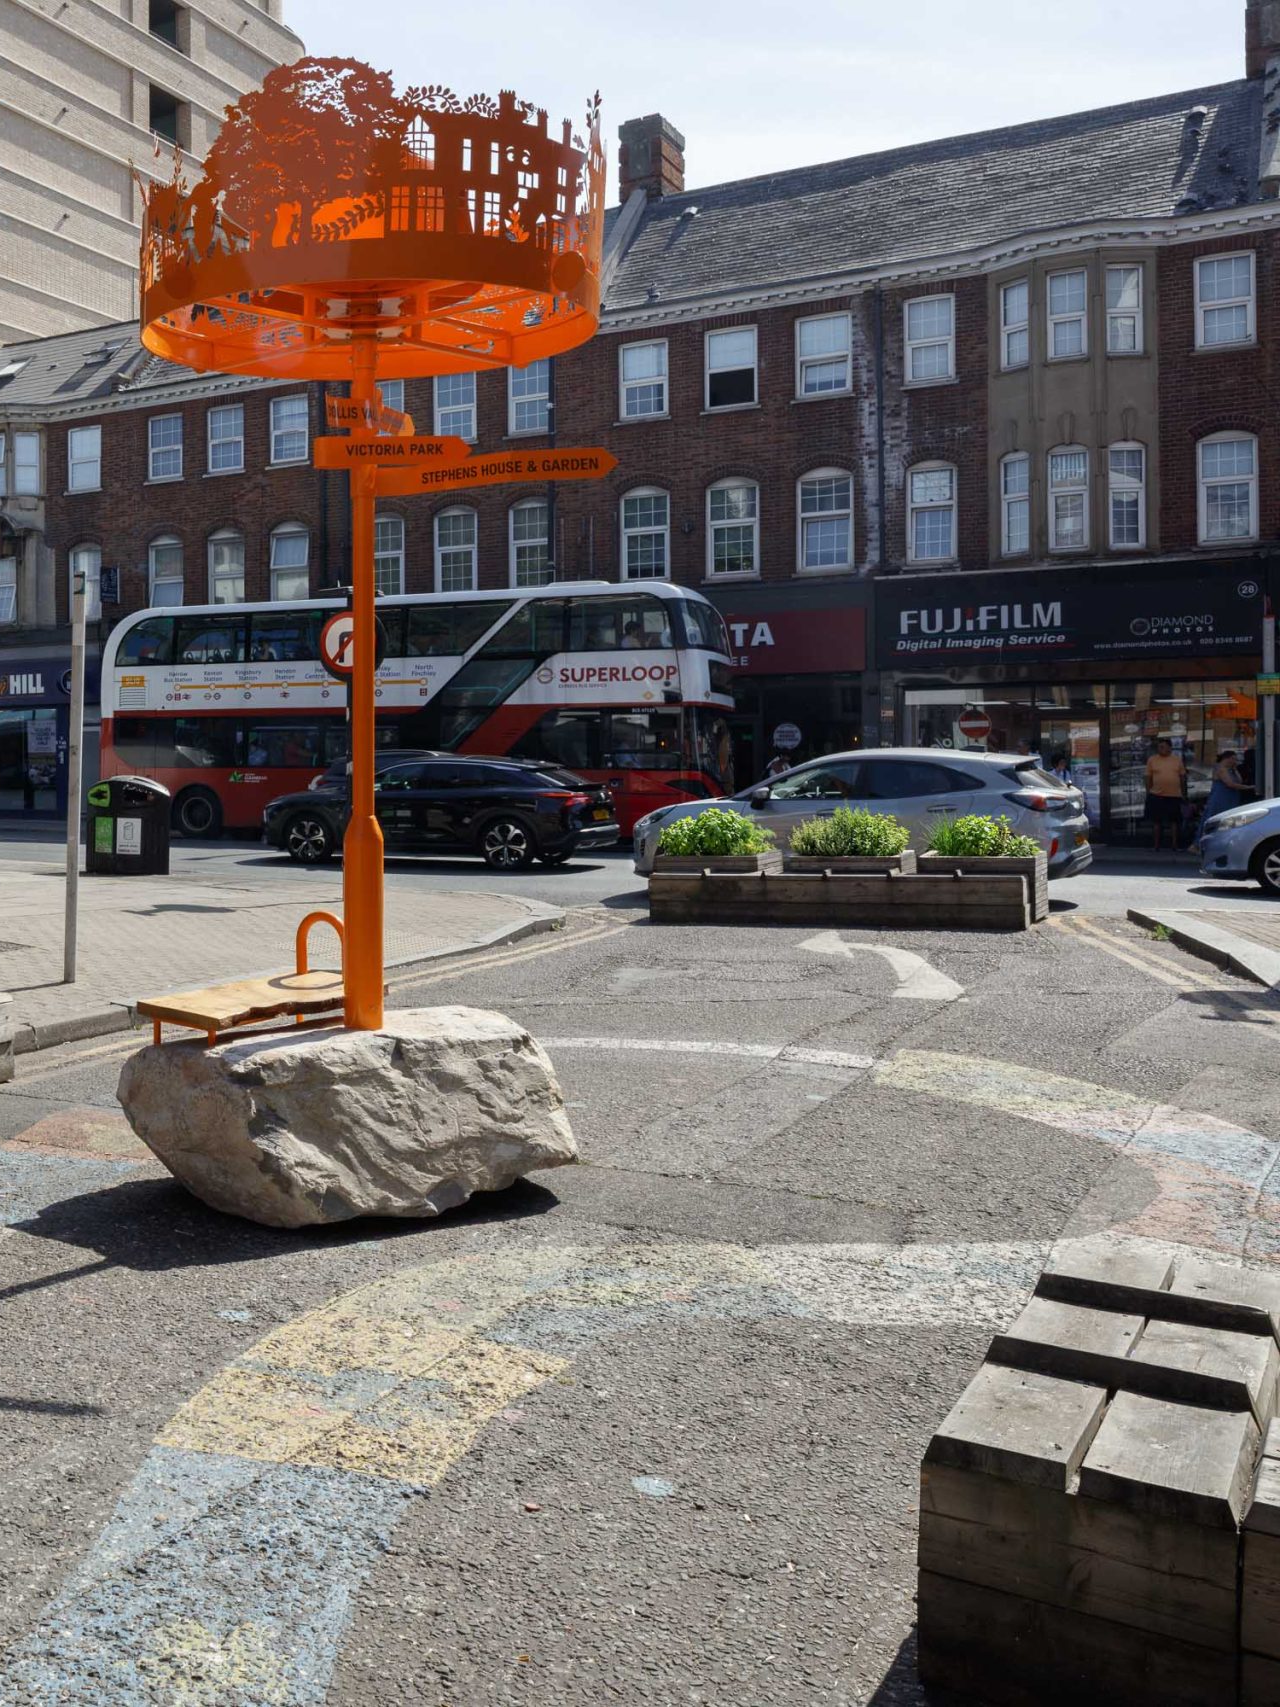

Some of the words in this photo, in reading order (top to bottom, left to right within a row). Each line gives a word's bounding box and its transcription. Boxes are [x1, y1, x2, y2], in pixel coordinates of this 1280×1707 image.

[346, 444, 405, 457] VICTORIA
[409, 443, 443, 455] PARK
[421, 466, 477, 485] STEPHENS
[481, 460, 522, 476] HOUSE
[527, 460, 537, 473] &
[542, 457, 599, 472] GARDEN
[1242, 585, 1255, 594] 28
[1151, 615, 1213, 628] DIAMOND
[896, 638, 941, 652] Digital
[946, 636, 1004, 649] Imaging
[1009, 633, 1066, 645] Service
[560, 666, 677, 682] SUPERLOOP
[9, 673, 45, 695] HILL
